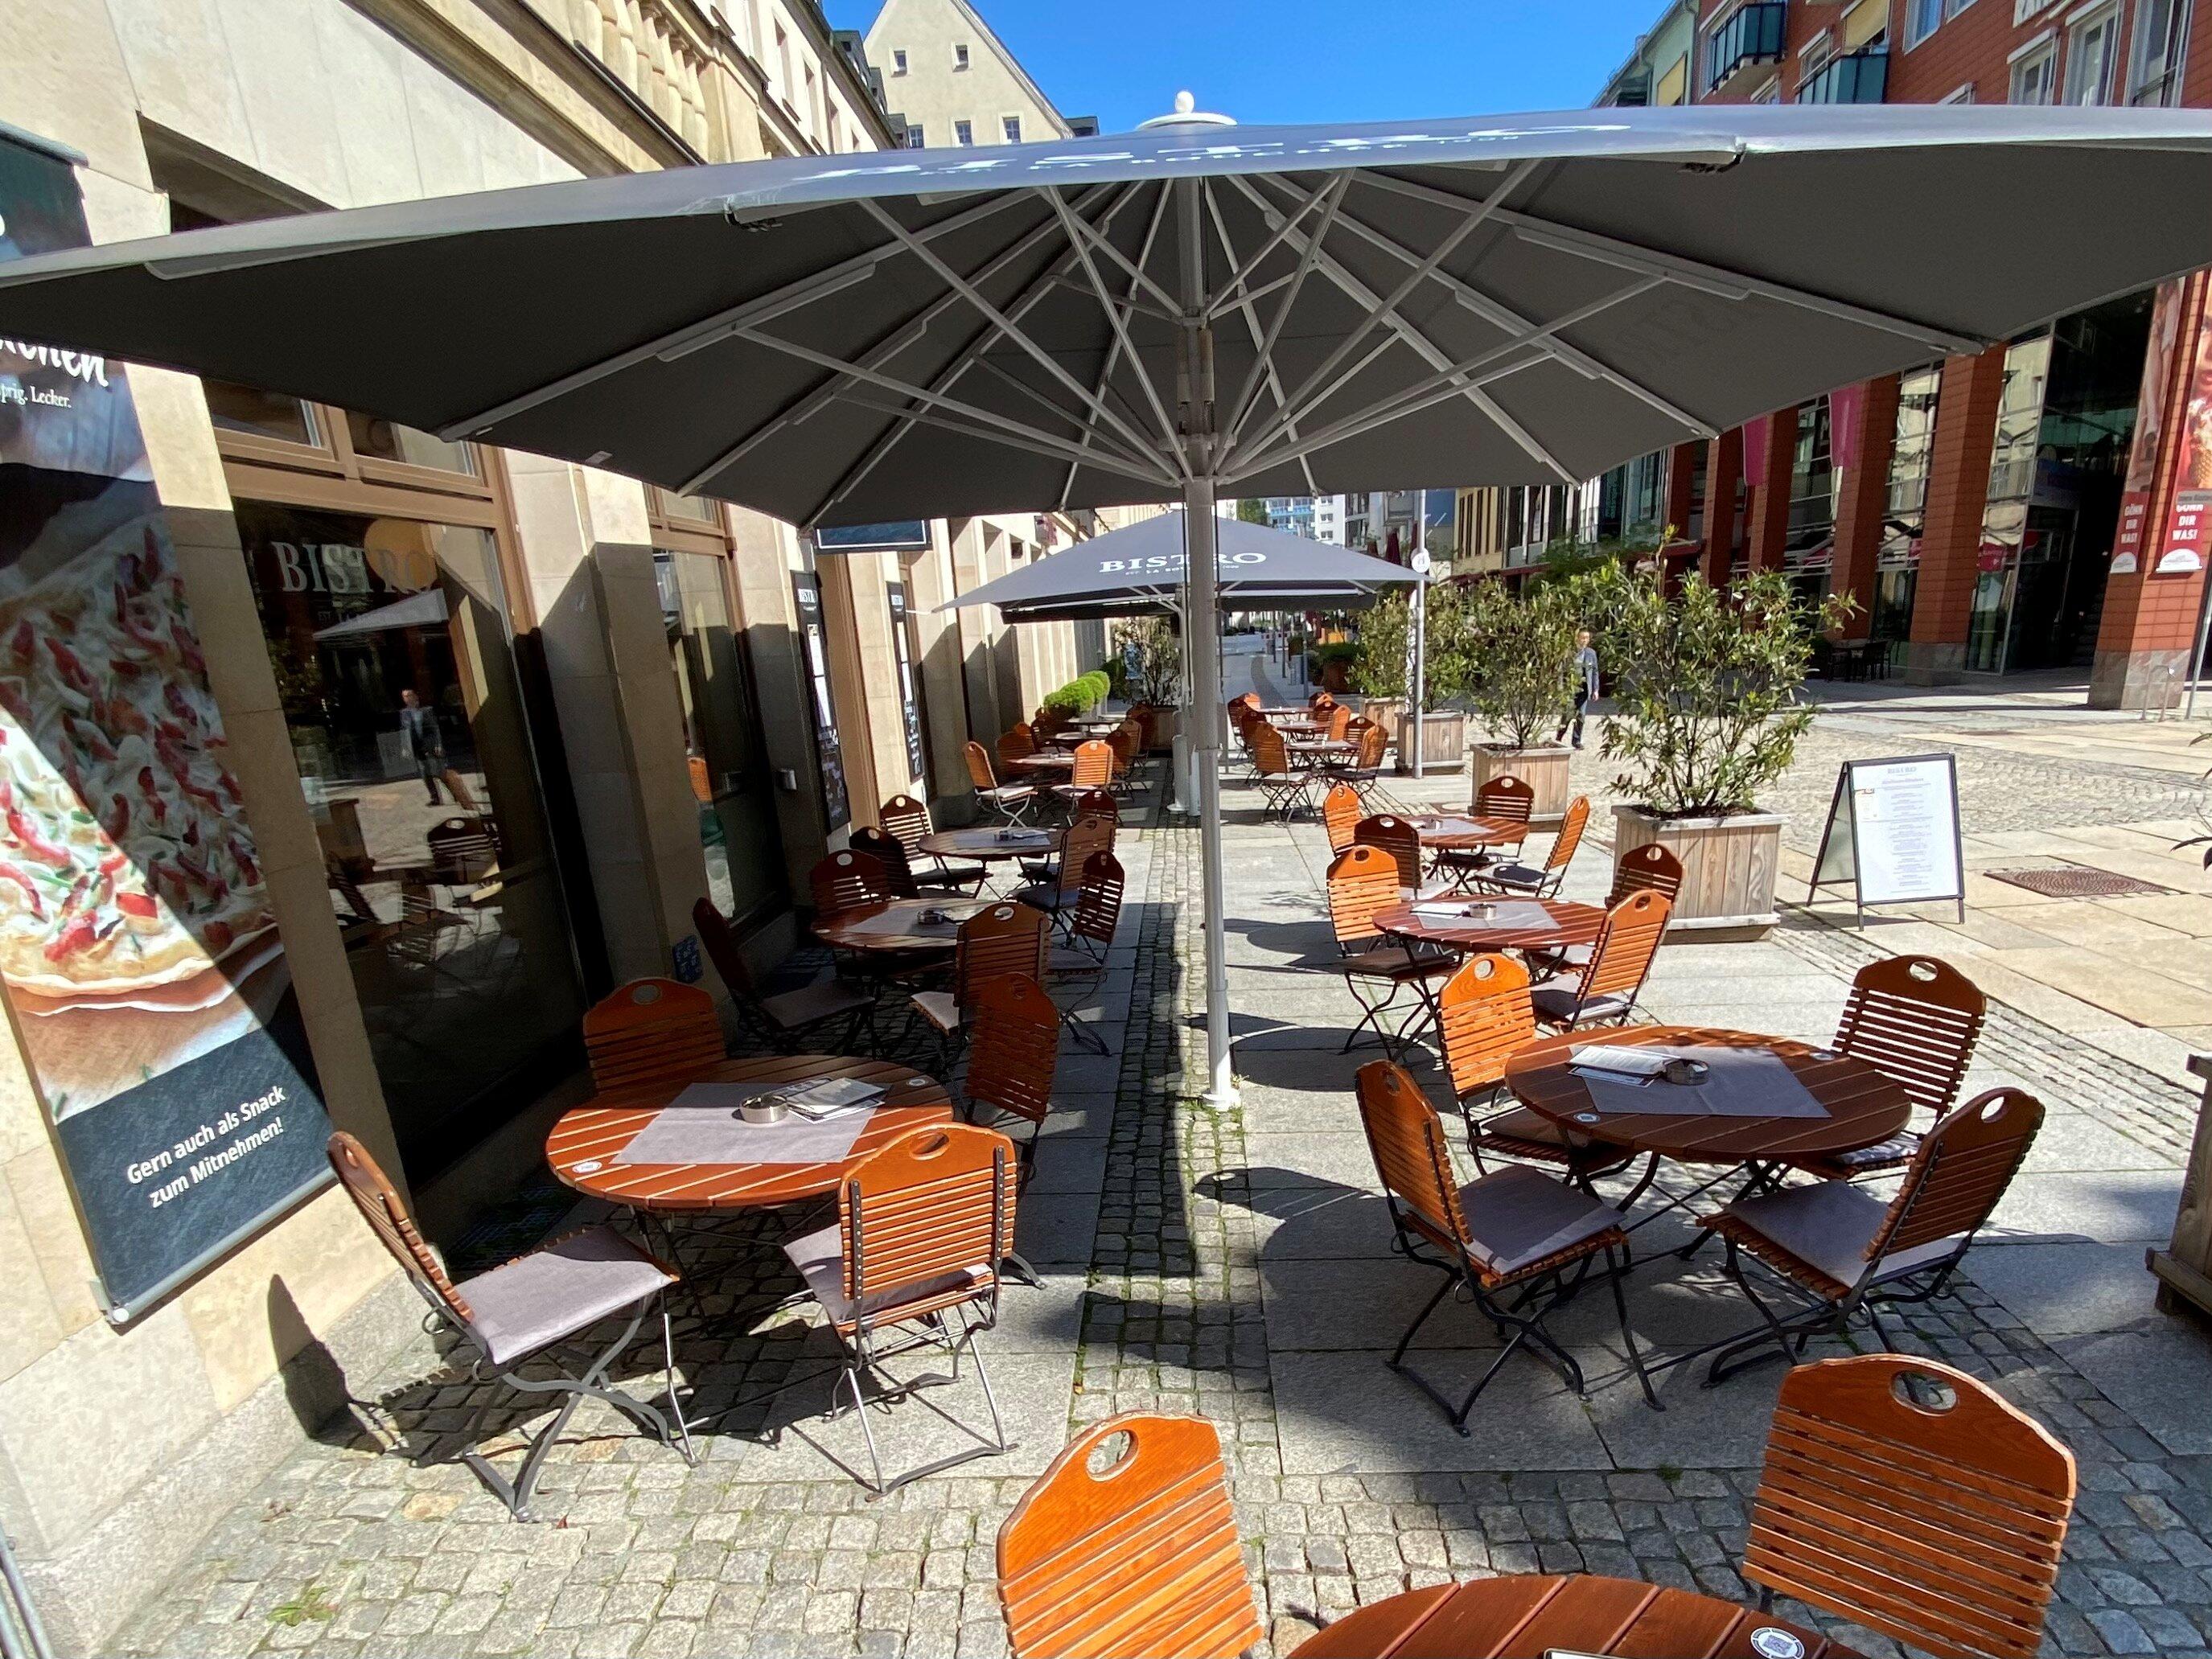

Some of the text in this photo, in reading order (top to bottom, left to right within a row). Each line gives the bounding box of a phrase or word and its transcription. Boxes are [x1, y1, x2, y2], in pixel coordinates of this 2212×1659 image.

[0, 383, 72, 409] prig. Lecker.
[2178, 515, 2197, 527] DIR
[127, 1086, 286, 1184] Gern auch als Snack
[149, 1116, 284, 1209] zum Mitnehmen!
